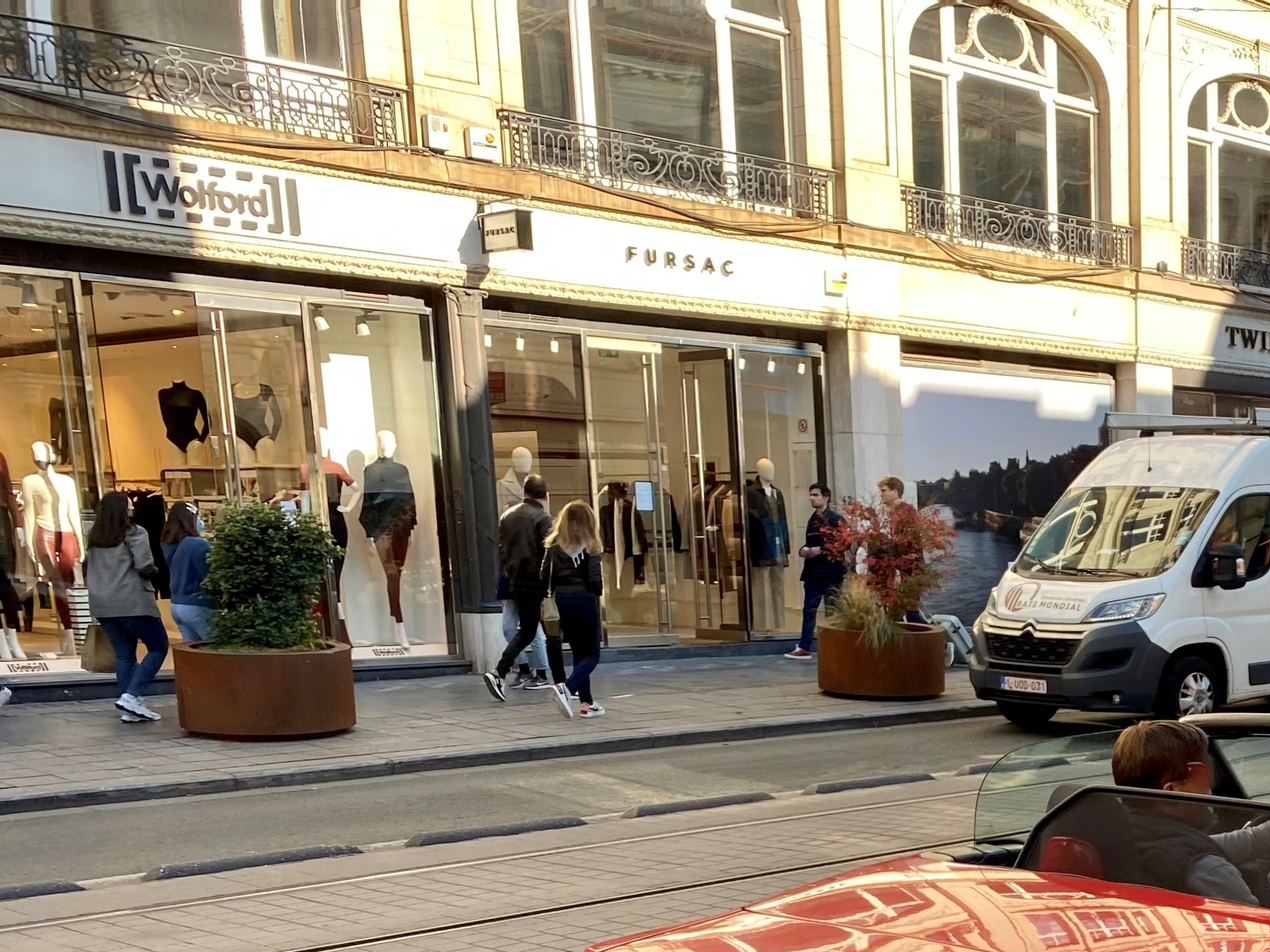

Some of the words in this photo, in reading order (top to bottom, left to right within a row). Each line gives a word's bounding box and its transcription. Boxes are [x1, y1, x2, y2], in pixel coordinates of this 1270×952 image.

[139, 171, 268, 217] Wolford
[485, 226, 516, 237] FURSAC
[625, 246, 734, 277] FURSAC
[1017, 600, 1037, 608] BATI
[1040, 601, 1081, 612] MONDIAL
